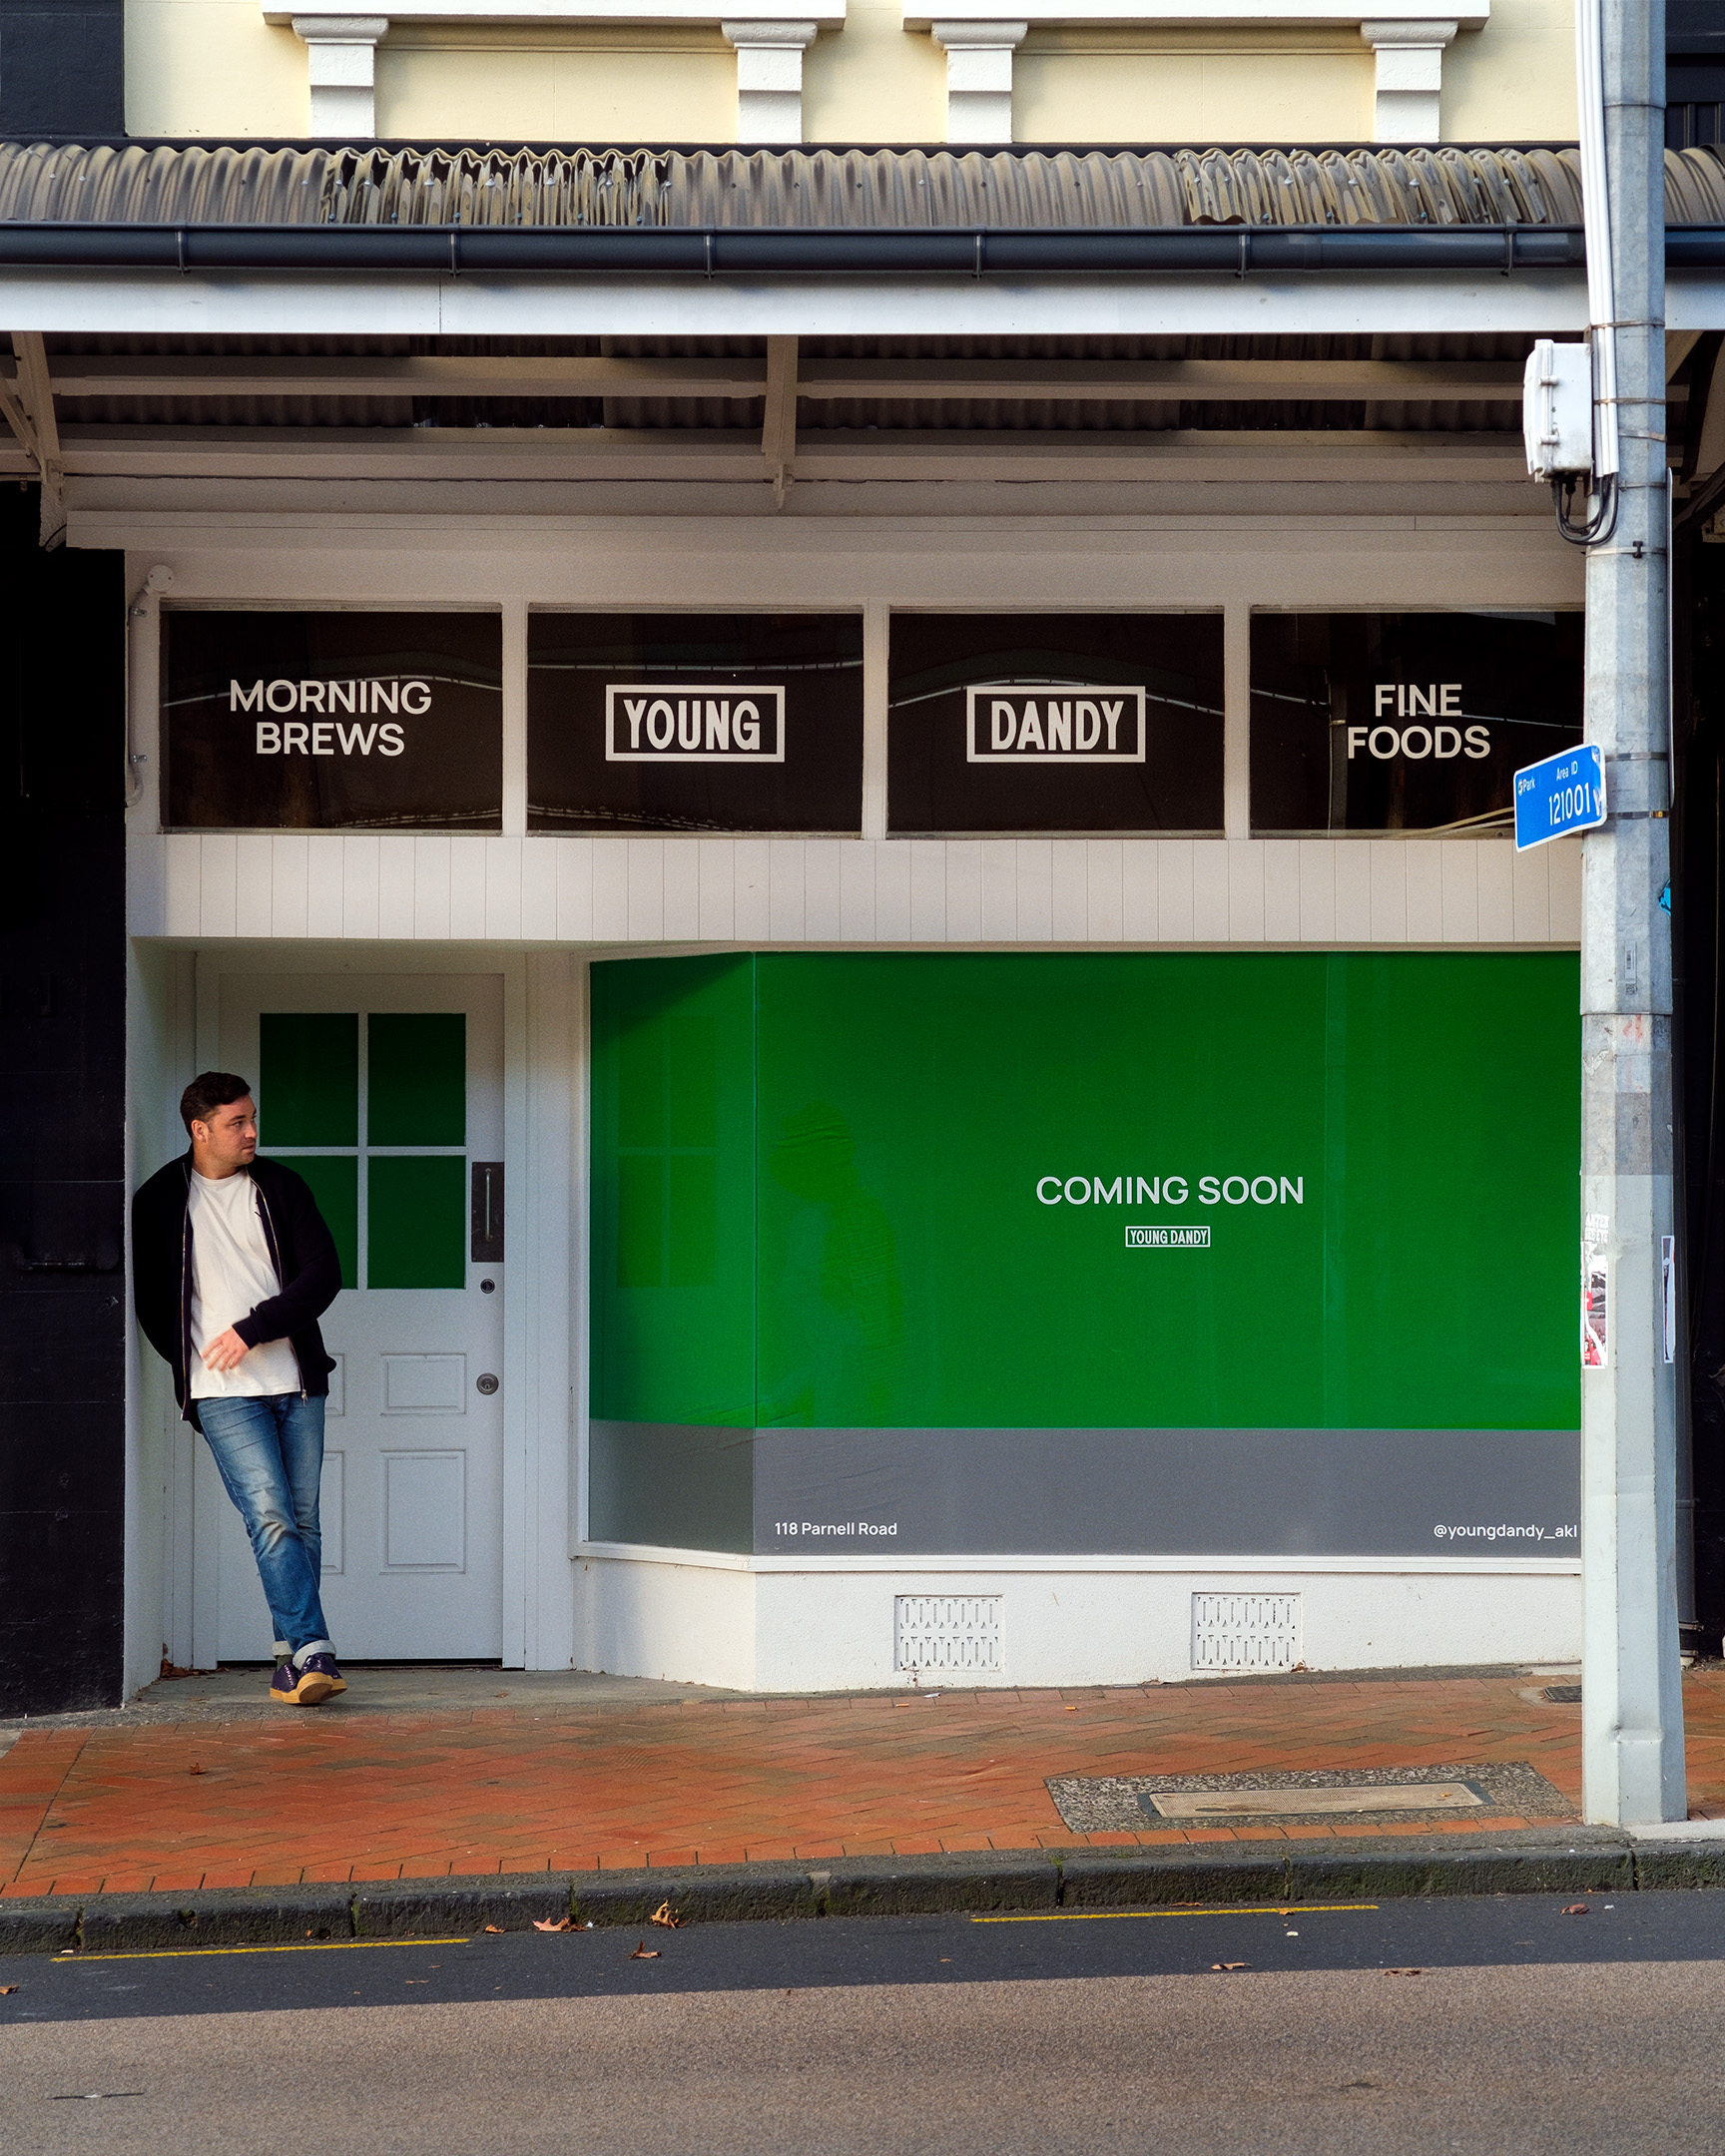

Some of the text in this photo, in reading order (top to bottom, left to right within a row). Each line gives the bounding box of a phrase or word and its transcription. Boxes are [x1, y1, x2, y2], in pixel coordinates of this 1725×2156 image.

[230, 679, 432, 715] MORNING
[1375, 684, 1463, 718] FINE
[256, 722, 405, 757] BREWS
[623, 699, 762, 752] YOUNG
[991, 700, 1124, 752] DANDY
[1348, 725, 1491, 761] FOODS
[1555, 761, 1578, 782] Area ID
[1548, 783, 1591, 826] 121001
[1036, 1176, 1304, 1206] COMING SOON
[1129, 1229, 1208, 1245] YOUNG DANDY
[774, 1521, 897, 1536] 118 Parnell Road
[1434, 1523, 1578, 1541] @youngdandy_akl
